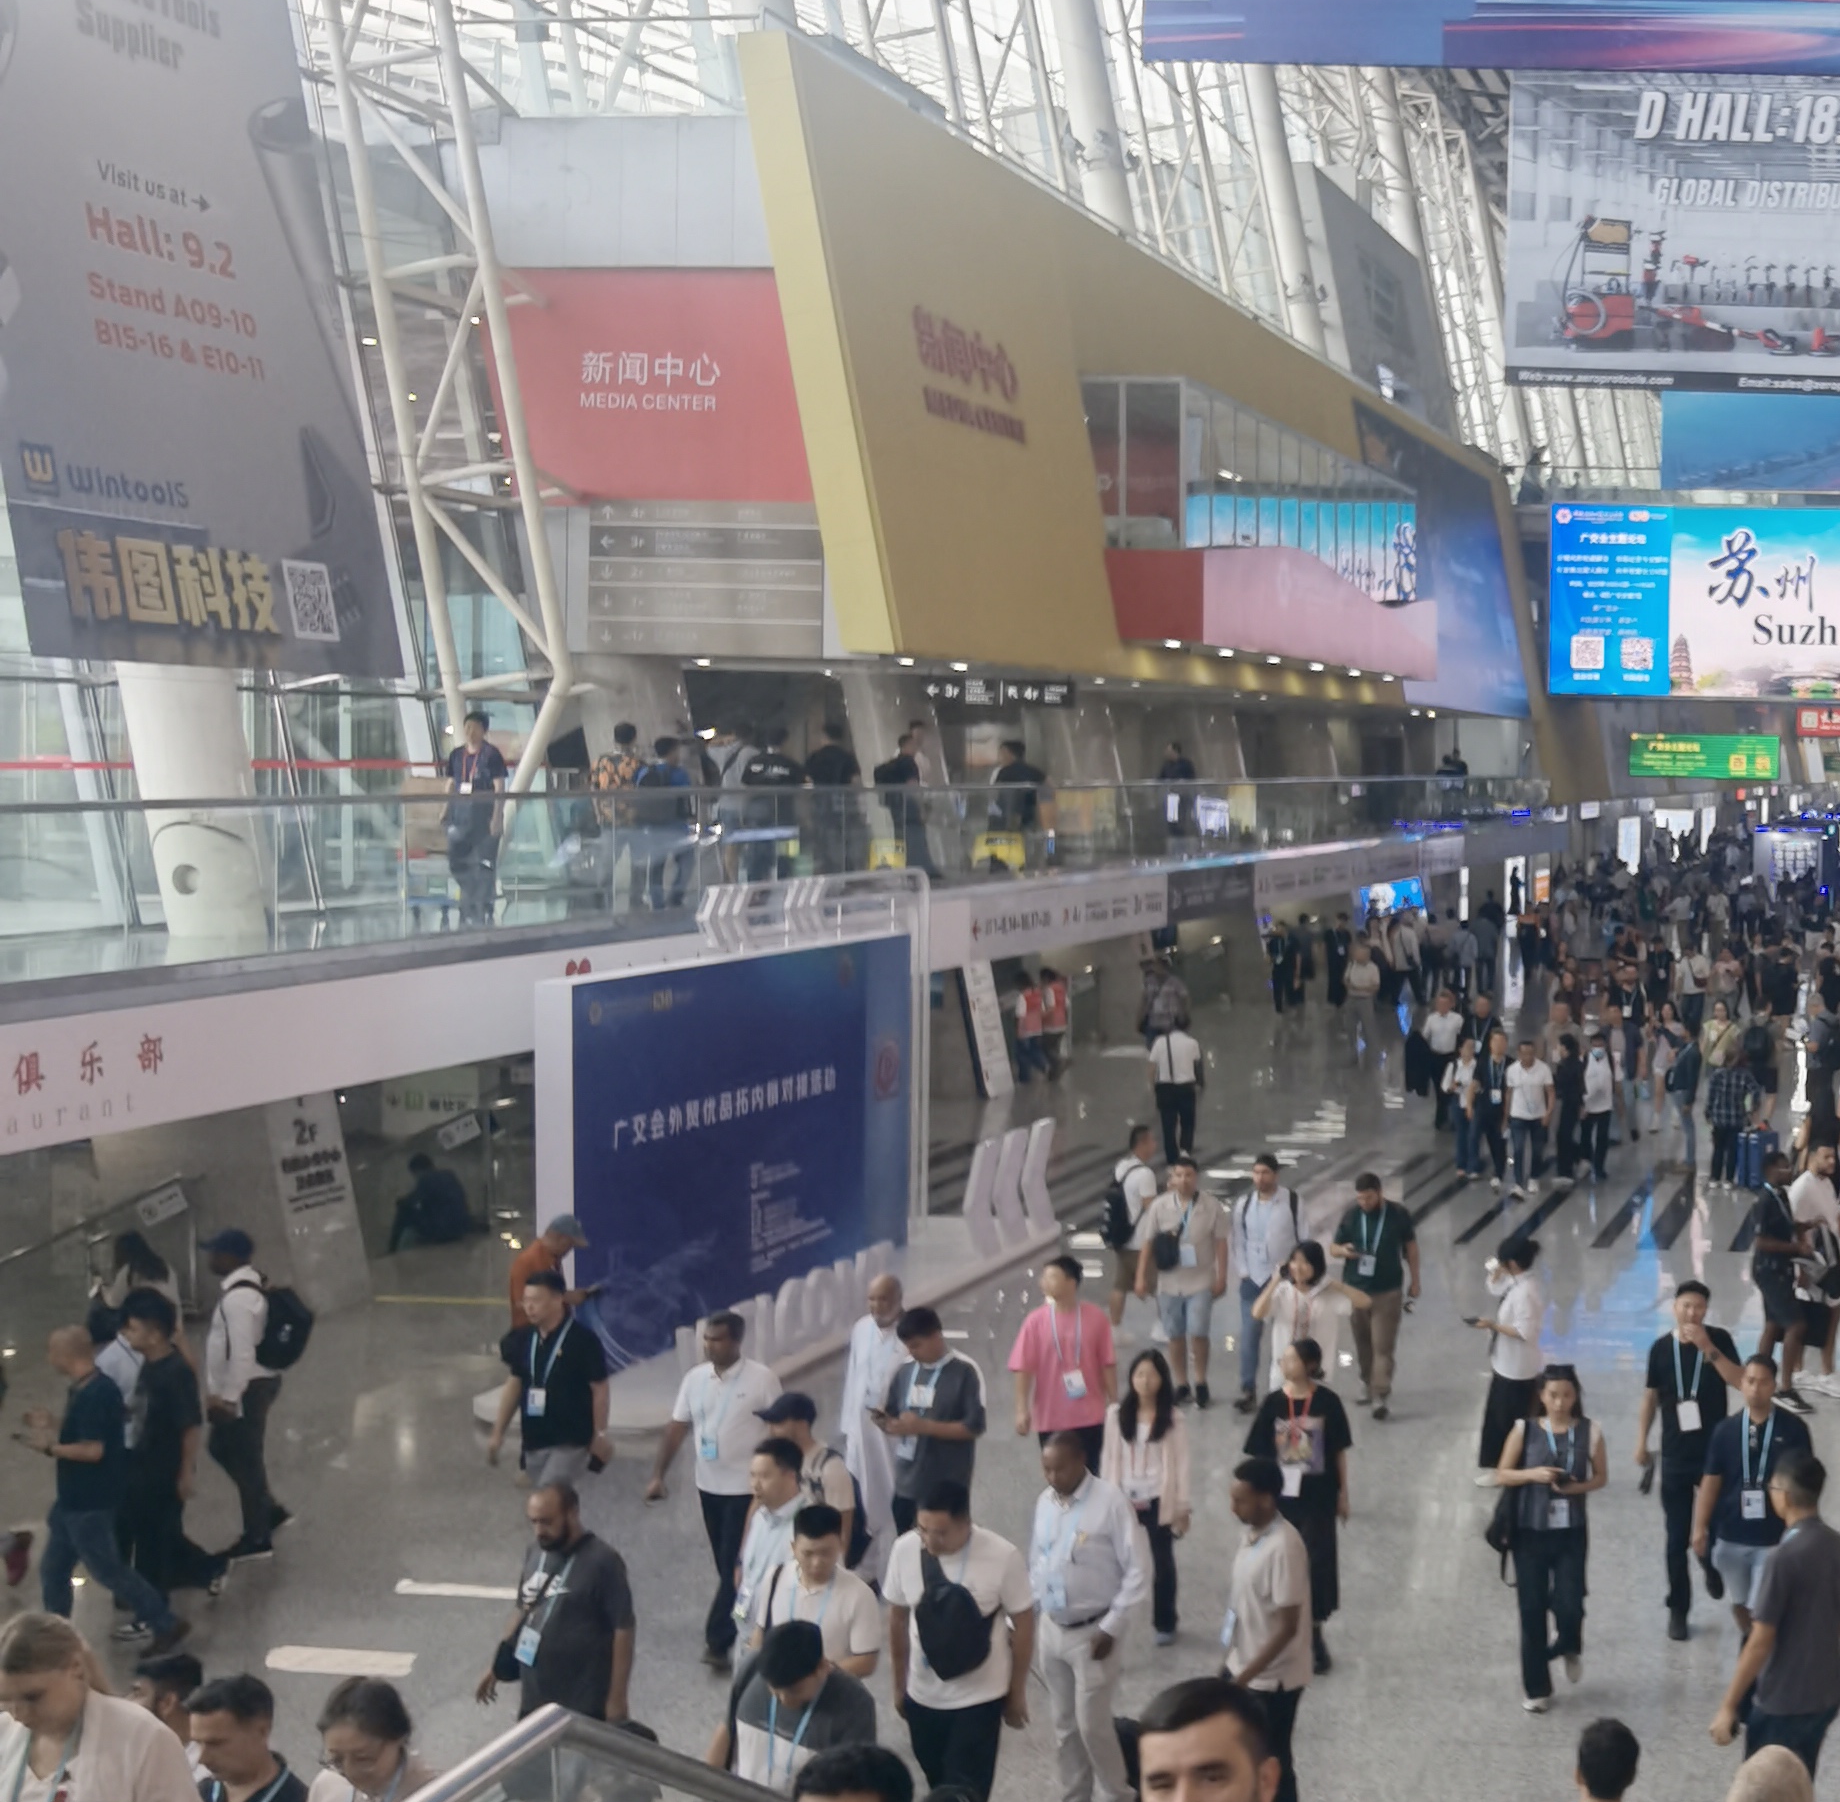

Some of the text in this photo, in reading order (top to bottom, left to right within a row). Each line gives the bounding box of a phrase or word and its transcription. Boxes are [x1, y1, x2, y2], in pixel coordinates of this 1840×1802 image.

[1635, 90, 1667, 140] D
[97, 159, 188, 208] Visit us at
[1655, 176, 1742, 209] GLOBAL
[85, 202, 236, 281] Hall: 9.2
[87, 270, 258, 340] Stand A09-10
[95, 318, 173, 360] B15-16
[203, 344, 267, 383] E10-11
[580, 350, 721, 389] 新闻中心
[580, 392, 718, 412] MEDIA CENTER
[57, 527, 281, 636] 伟图科技
[1706, 528, 1817, 612] 苏州
[13, 1033, 165, 1096] 俱乐部
